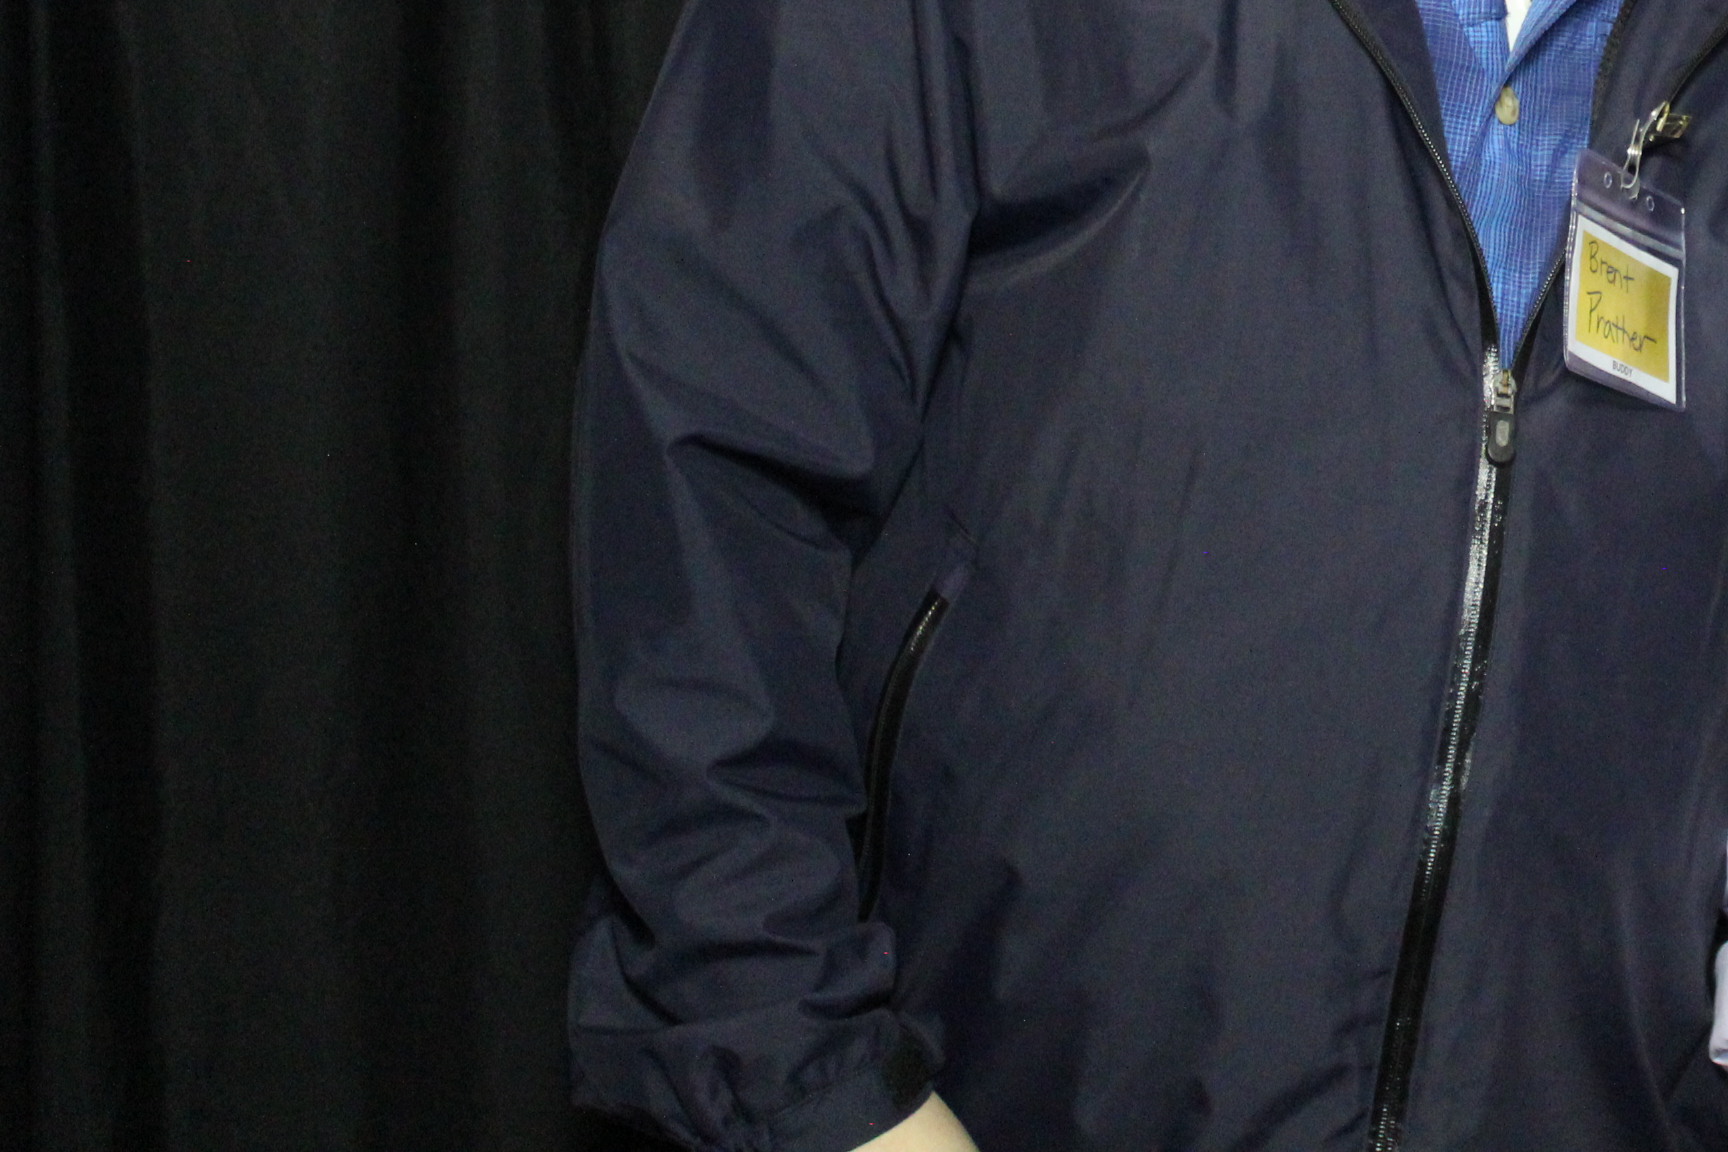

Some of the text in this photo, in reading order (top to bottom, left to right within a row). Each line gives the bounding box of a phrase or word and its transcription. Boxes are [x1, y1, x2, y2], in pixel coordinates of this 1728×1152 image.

[1588, 240, 1635, 293] Brent
[1586, 290, 1657, 352] Prather
[1612, 359, 1633, 377] BUDDY
